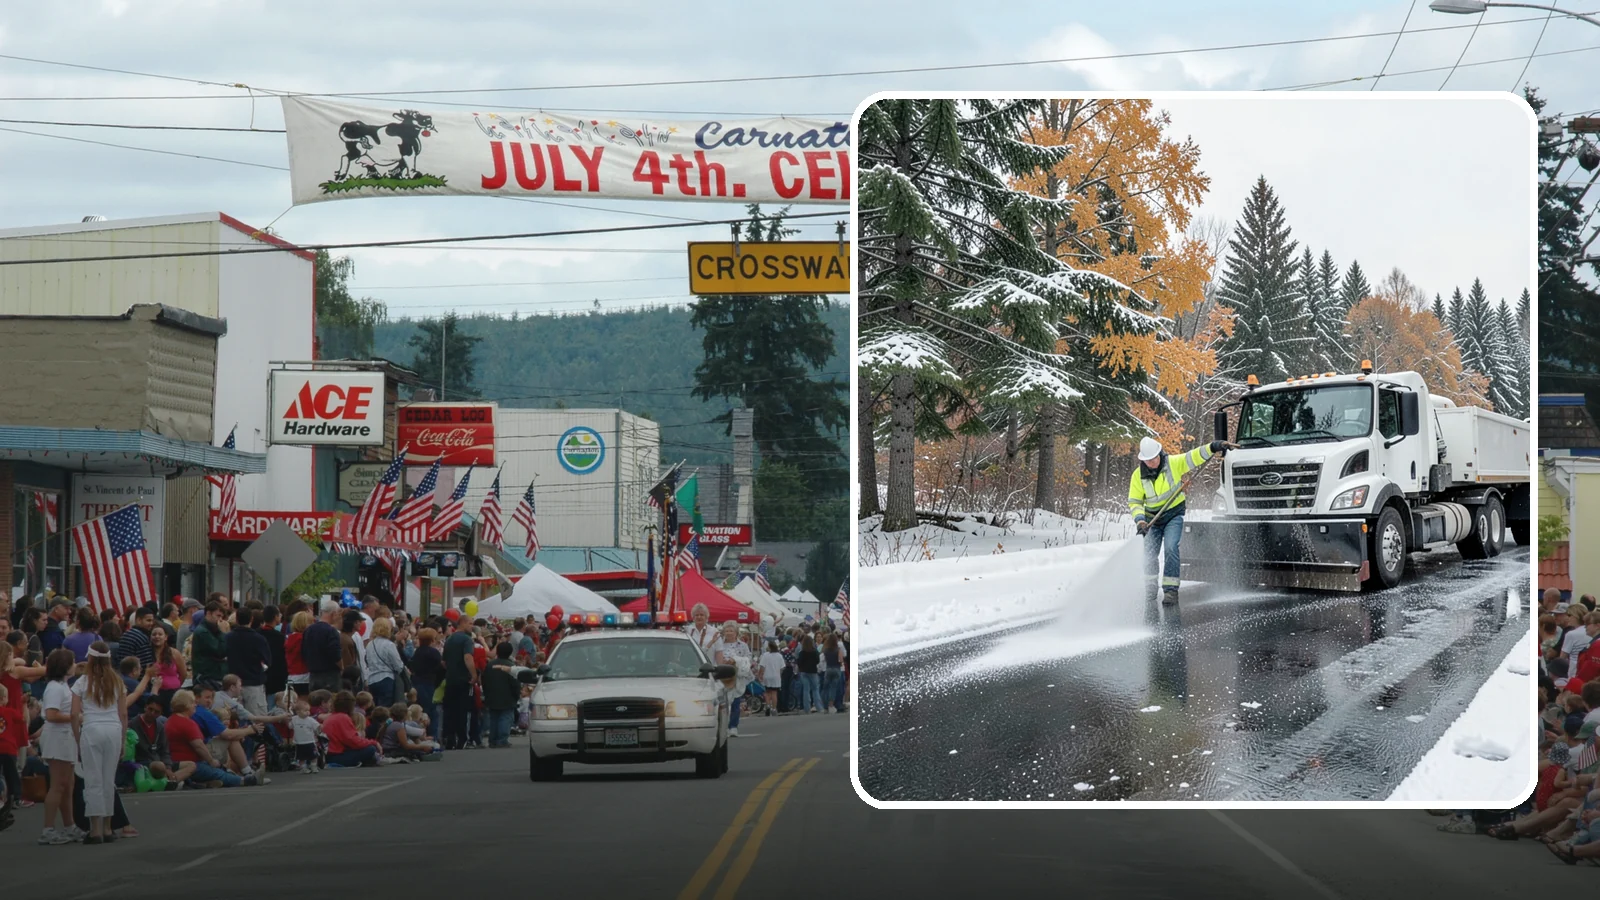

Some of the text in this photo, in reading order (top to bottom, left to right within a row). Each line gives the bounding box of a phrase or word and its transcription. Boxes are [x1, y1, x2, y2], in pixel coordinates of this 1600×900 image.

[695, 121, 850, 150] Carnat
[481, 141, 605, 192] JULY
[632, 150, 746, 198] 4th.
[697, 254, 850, 280] CROSSWA
[282, 380, 374, 420] ACE
[405, 409, 453, 422] CEDAR
[283, 421, 371, 437] Hardware
[353, 467, 385, 482] Simpl
[96, 485, 124, 495] Vincent
[126, 486, 136, 495] de
[137, 486, 155, 495] Paul
[81, 503, 154, 522] THT
[212, 516, 331, 536] HARDARE
[688, 526, 741, 535] CRNATION
[699, 535, 730, 543] GLASS
